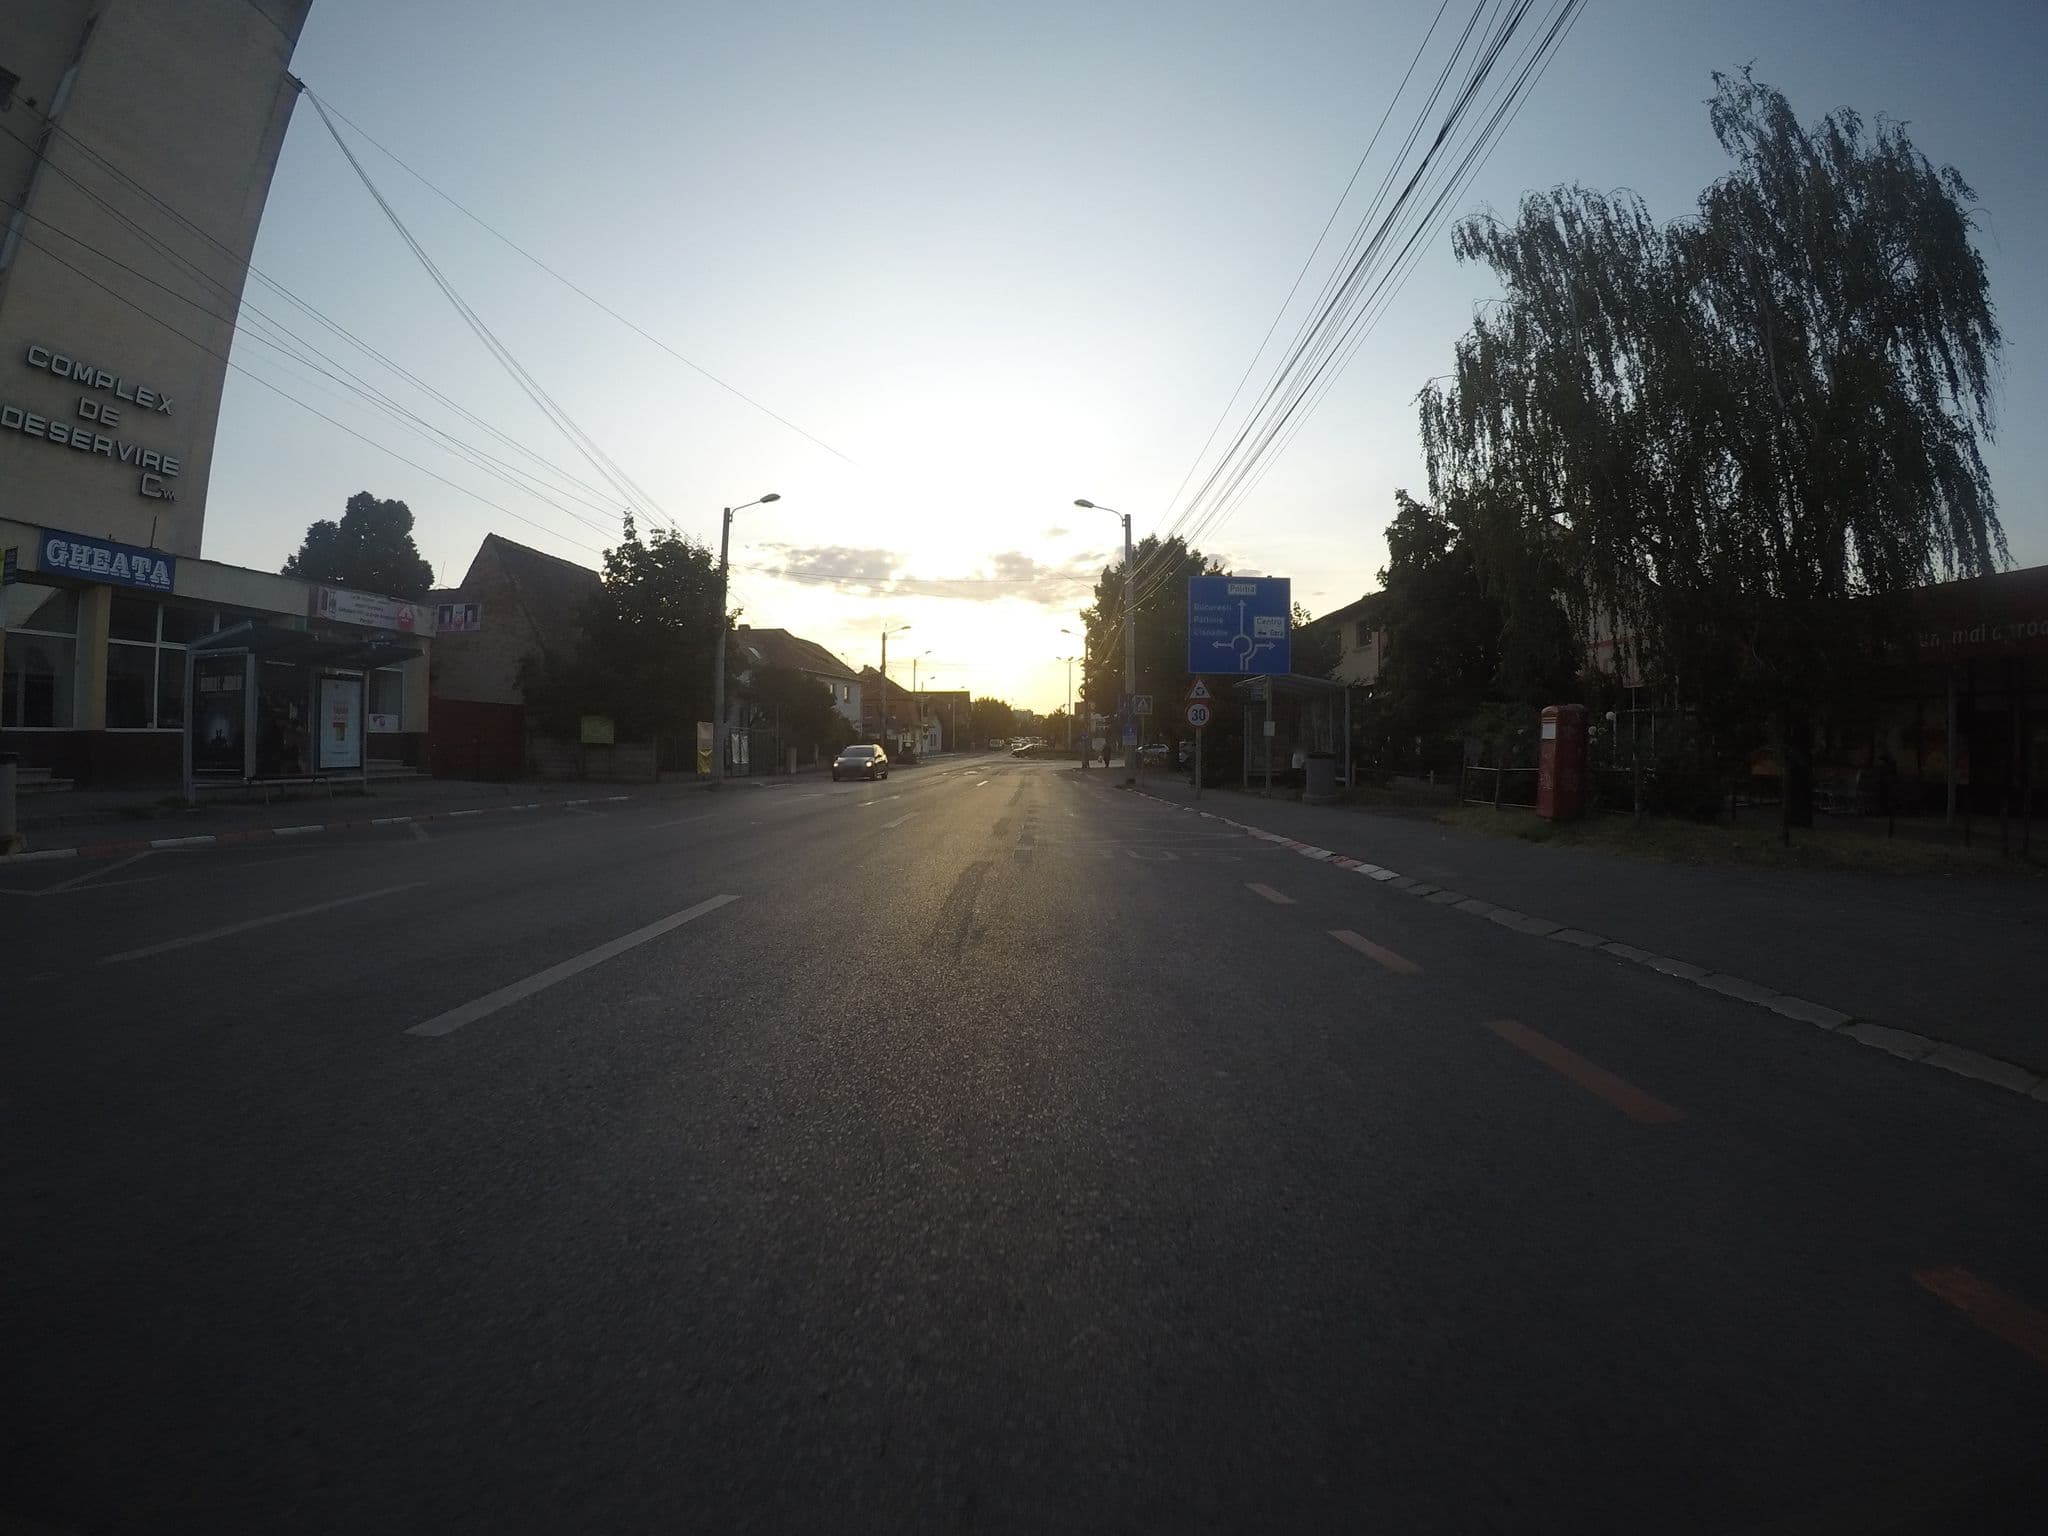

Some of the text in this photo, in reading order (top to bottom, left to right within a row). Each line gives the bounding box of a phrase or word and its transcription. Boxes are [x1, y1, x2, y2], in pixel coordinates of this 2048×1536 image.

[27, 345, 173, 415] COMPLEX
[78, 397, 121, 427] DE
[1, 404, 180, 477] DESERVIRE
[46, 538, 171, 585] GHEATA
[1191, 708, 1206, 721] 30
